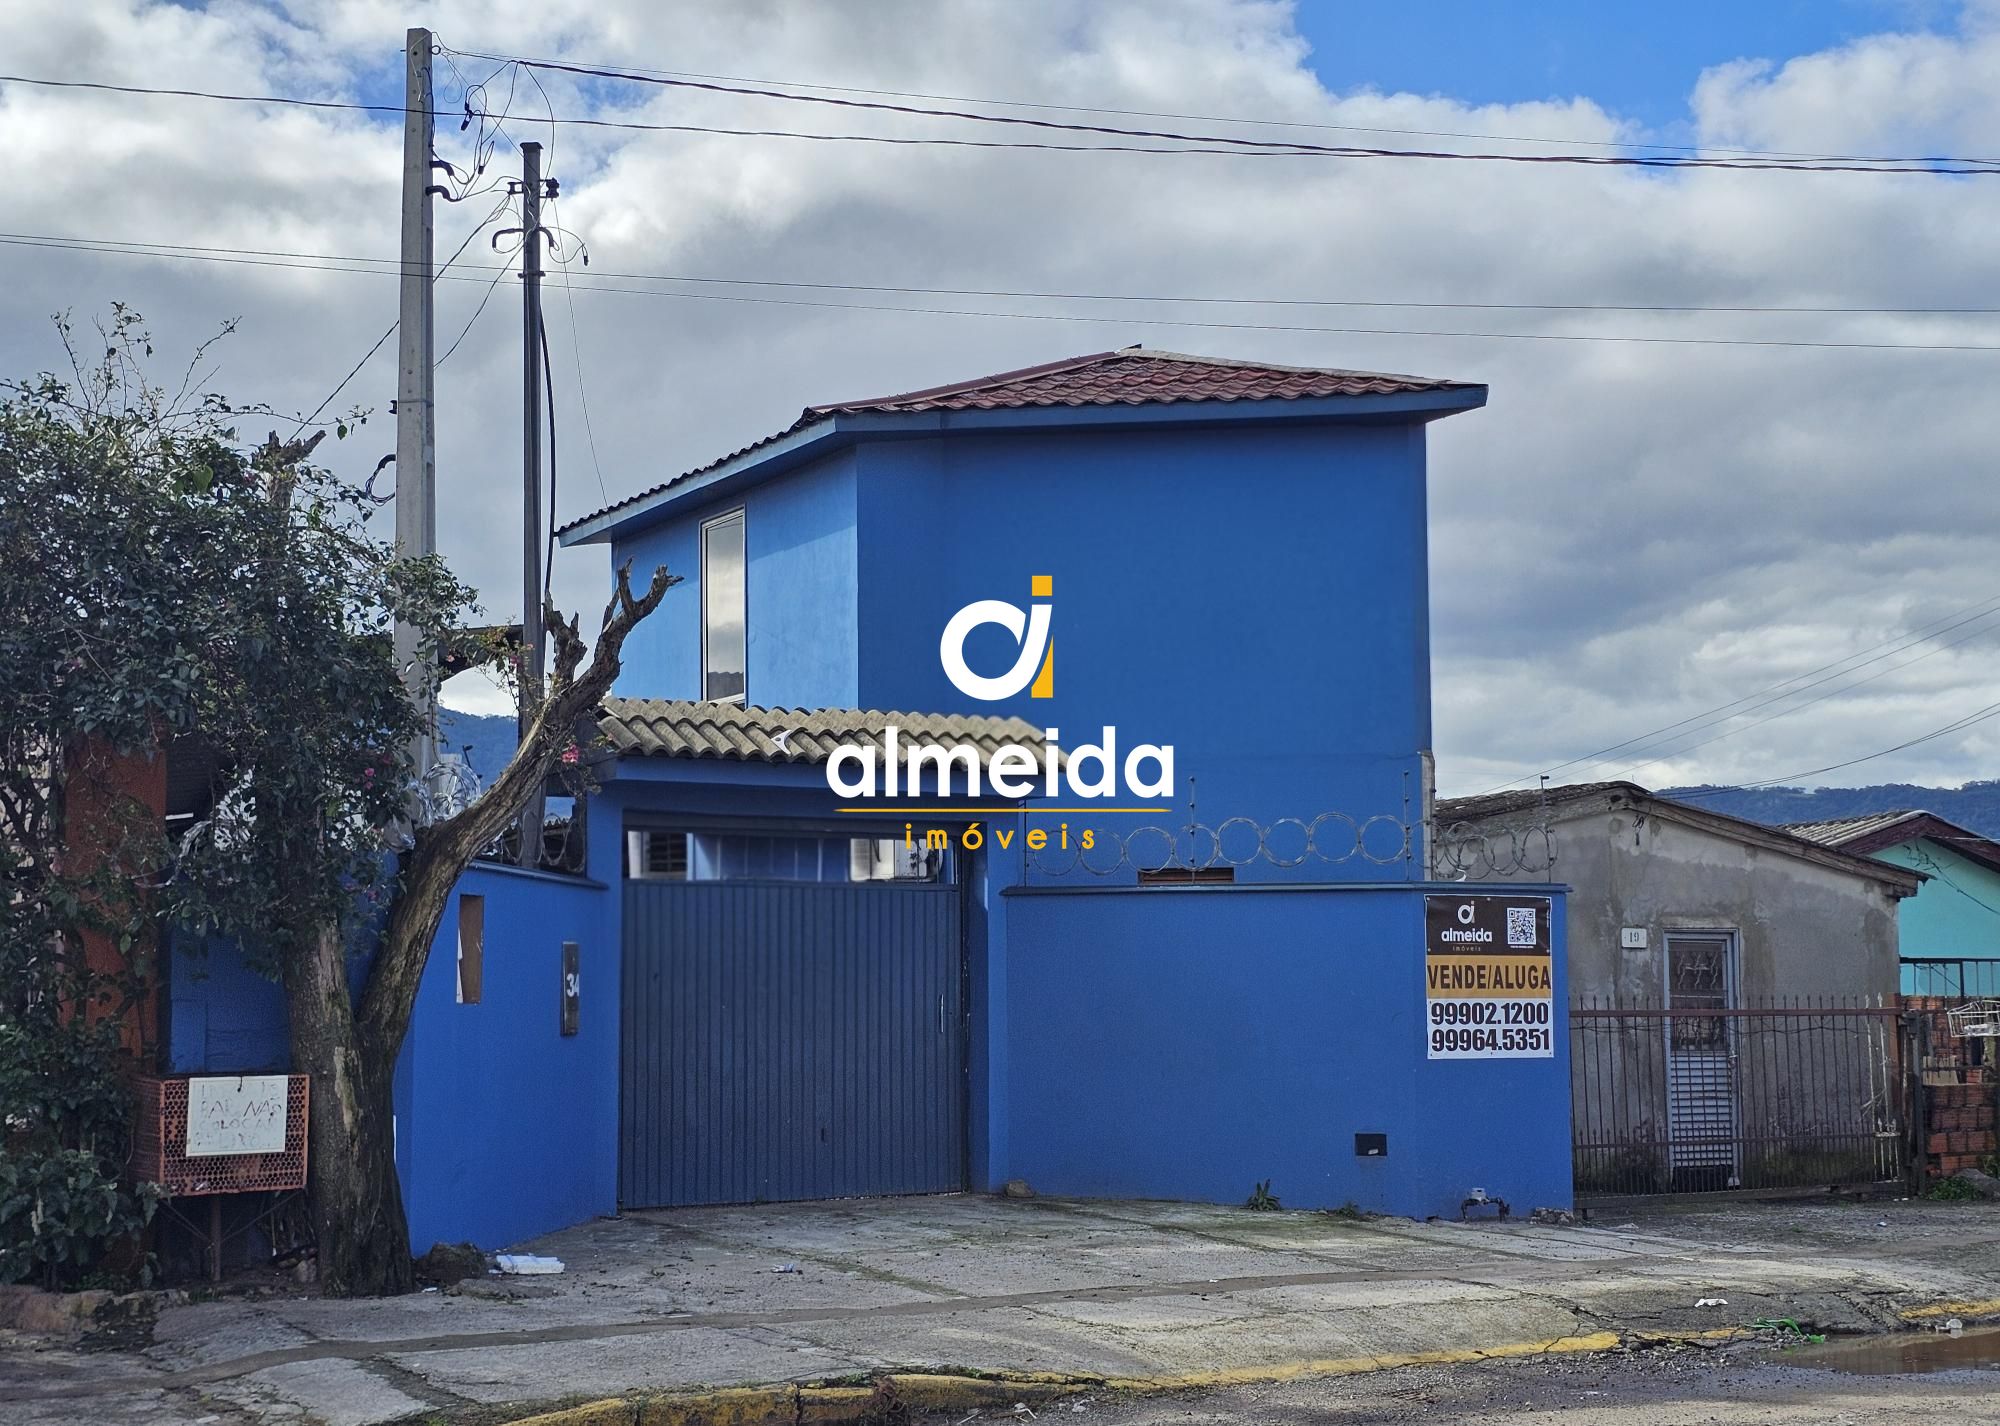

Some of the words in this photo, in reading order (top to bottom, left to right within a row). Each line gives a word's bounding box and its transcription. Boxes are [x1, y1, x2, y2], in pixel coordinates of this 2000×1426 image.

[1441, 927, 1493, 943] almeida
[1628, 932, 1640, 943] 19
[1452, 944, 1481, 952] imóveis
[1427, 964, 1552, 990] VENDE/ALUGA
[1431, 1002, 1549, 1025] 99902.1200
[1431, 1028, 1550, 1052] 99964.5351
